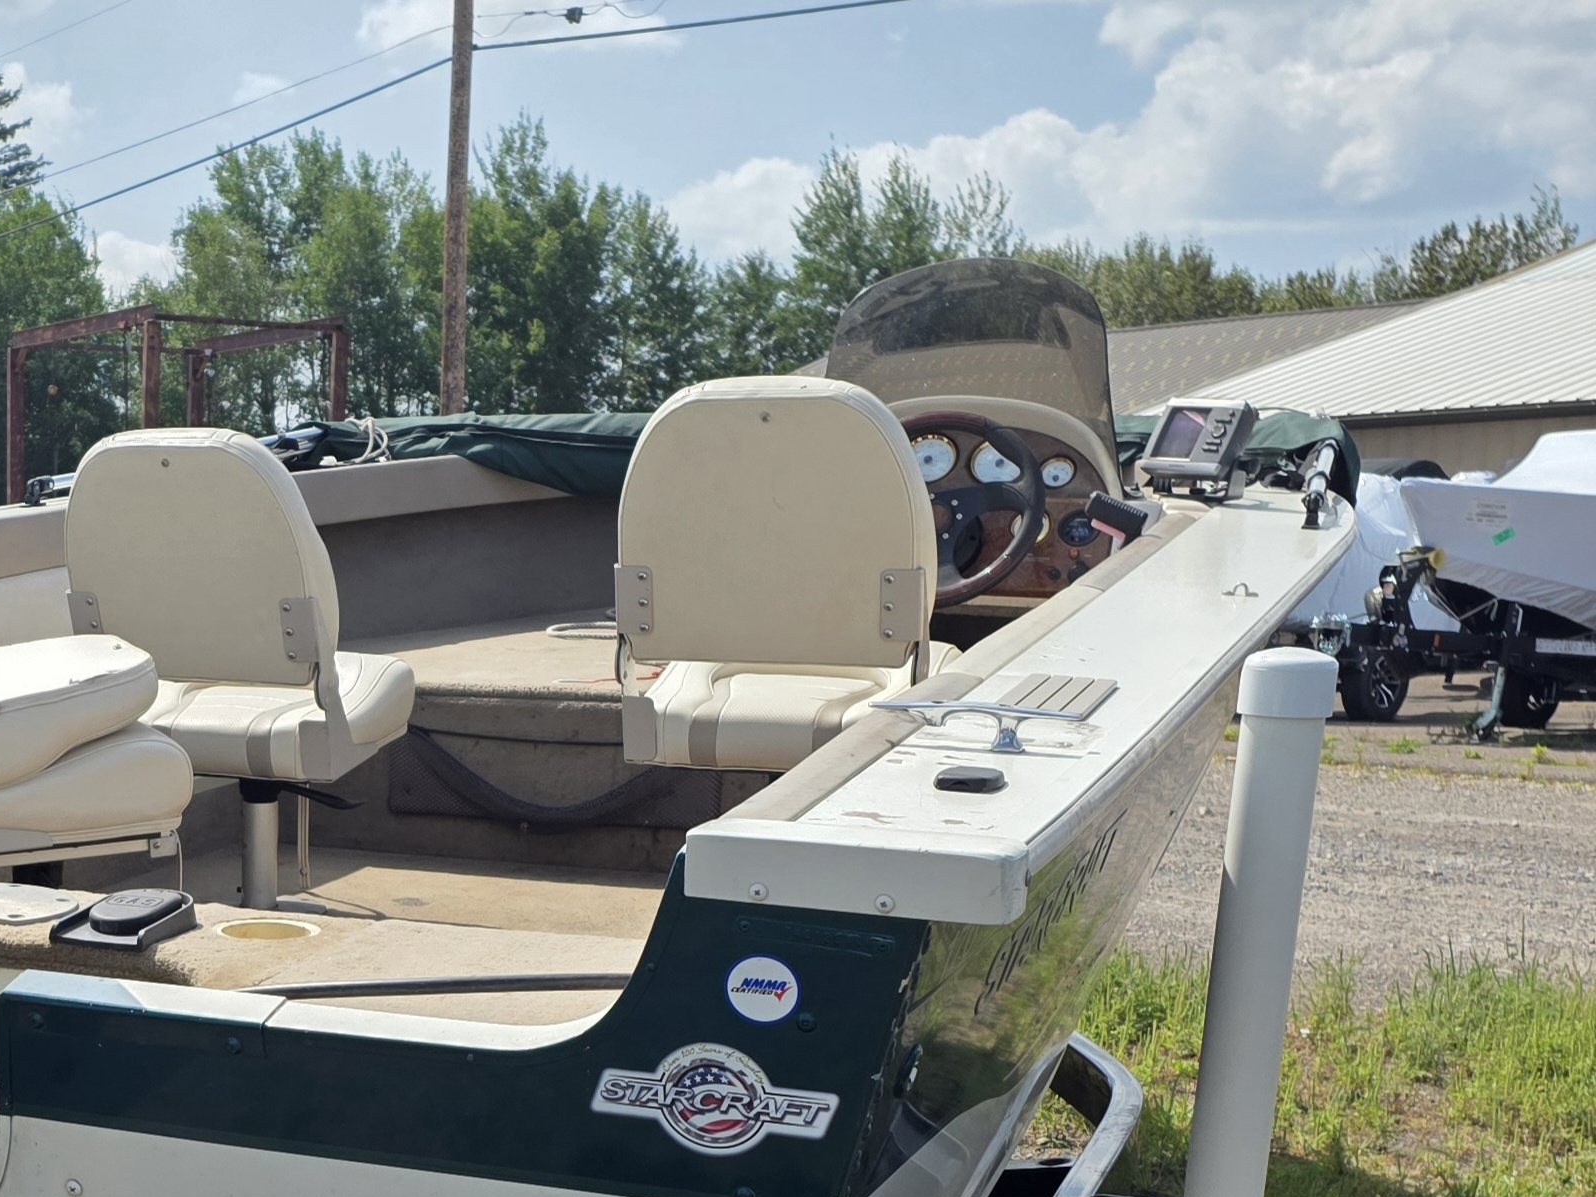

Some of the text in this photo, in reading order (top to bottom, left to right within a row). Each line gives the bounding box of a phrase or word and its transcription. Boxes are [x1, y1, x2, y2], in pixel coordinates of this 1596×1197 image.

[730, 986, 774, 996] CERTIFIED
[740, 977, 788, 991] NMMA
[601, 1079, 831, 1124] STARCRAFT
